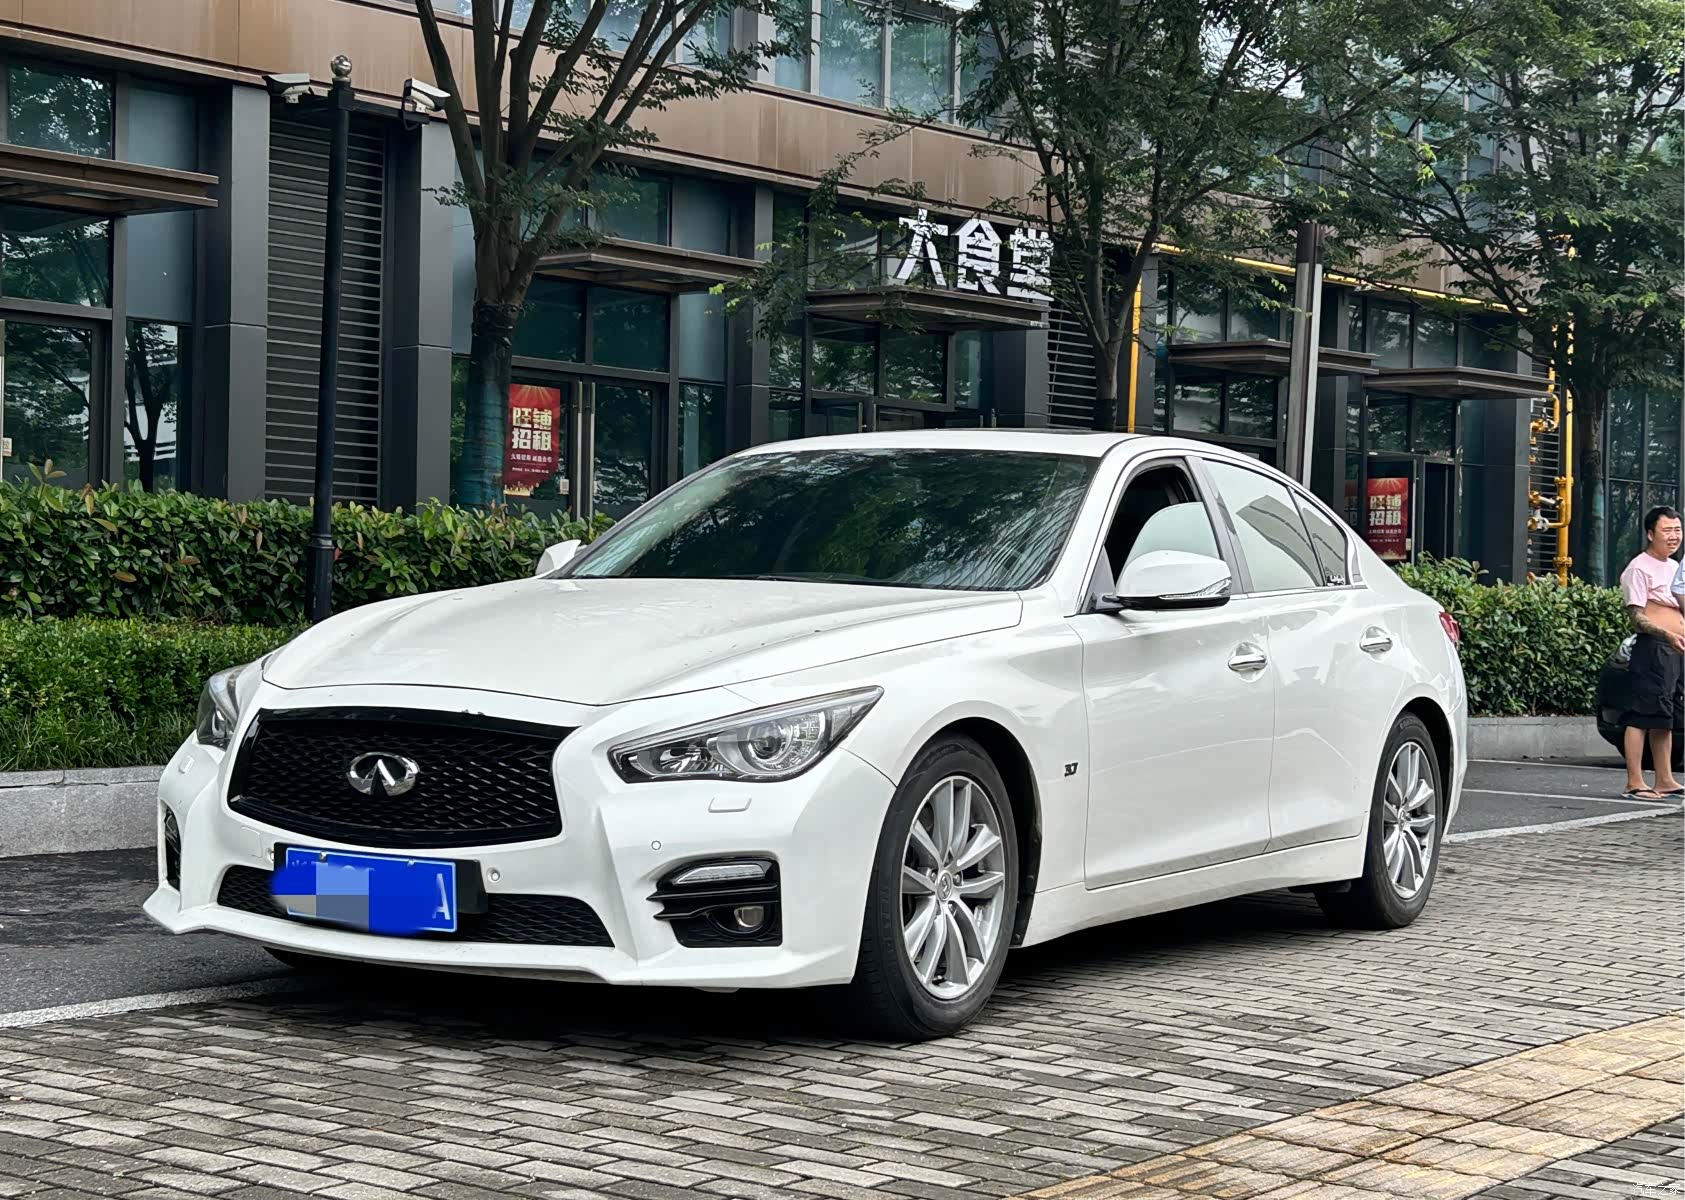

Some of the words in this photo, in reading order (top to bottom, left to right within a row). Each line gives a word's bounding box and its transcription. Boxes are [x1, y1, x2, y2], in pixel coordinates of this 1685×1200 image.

[896, 208, 1054, 302] 大食堂
[512, 407, 552, 430] 旺铺
[511, 427, 552, 451] 招租
[1369, 510, 1401, 526] 招租
